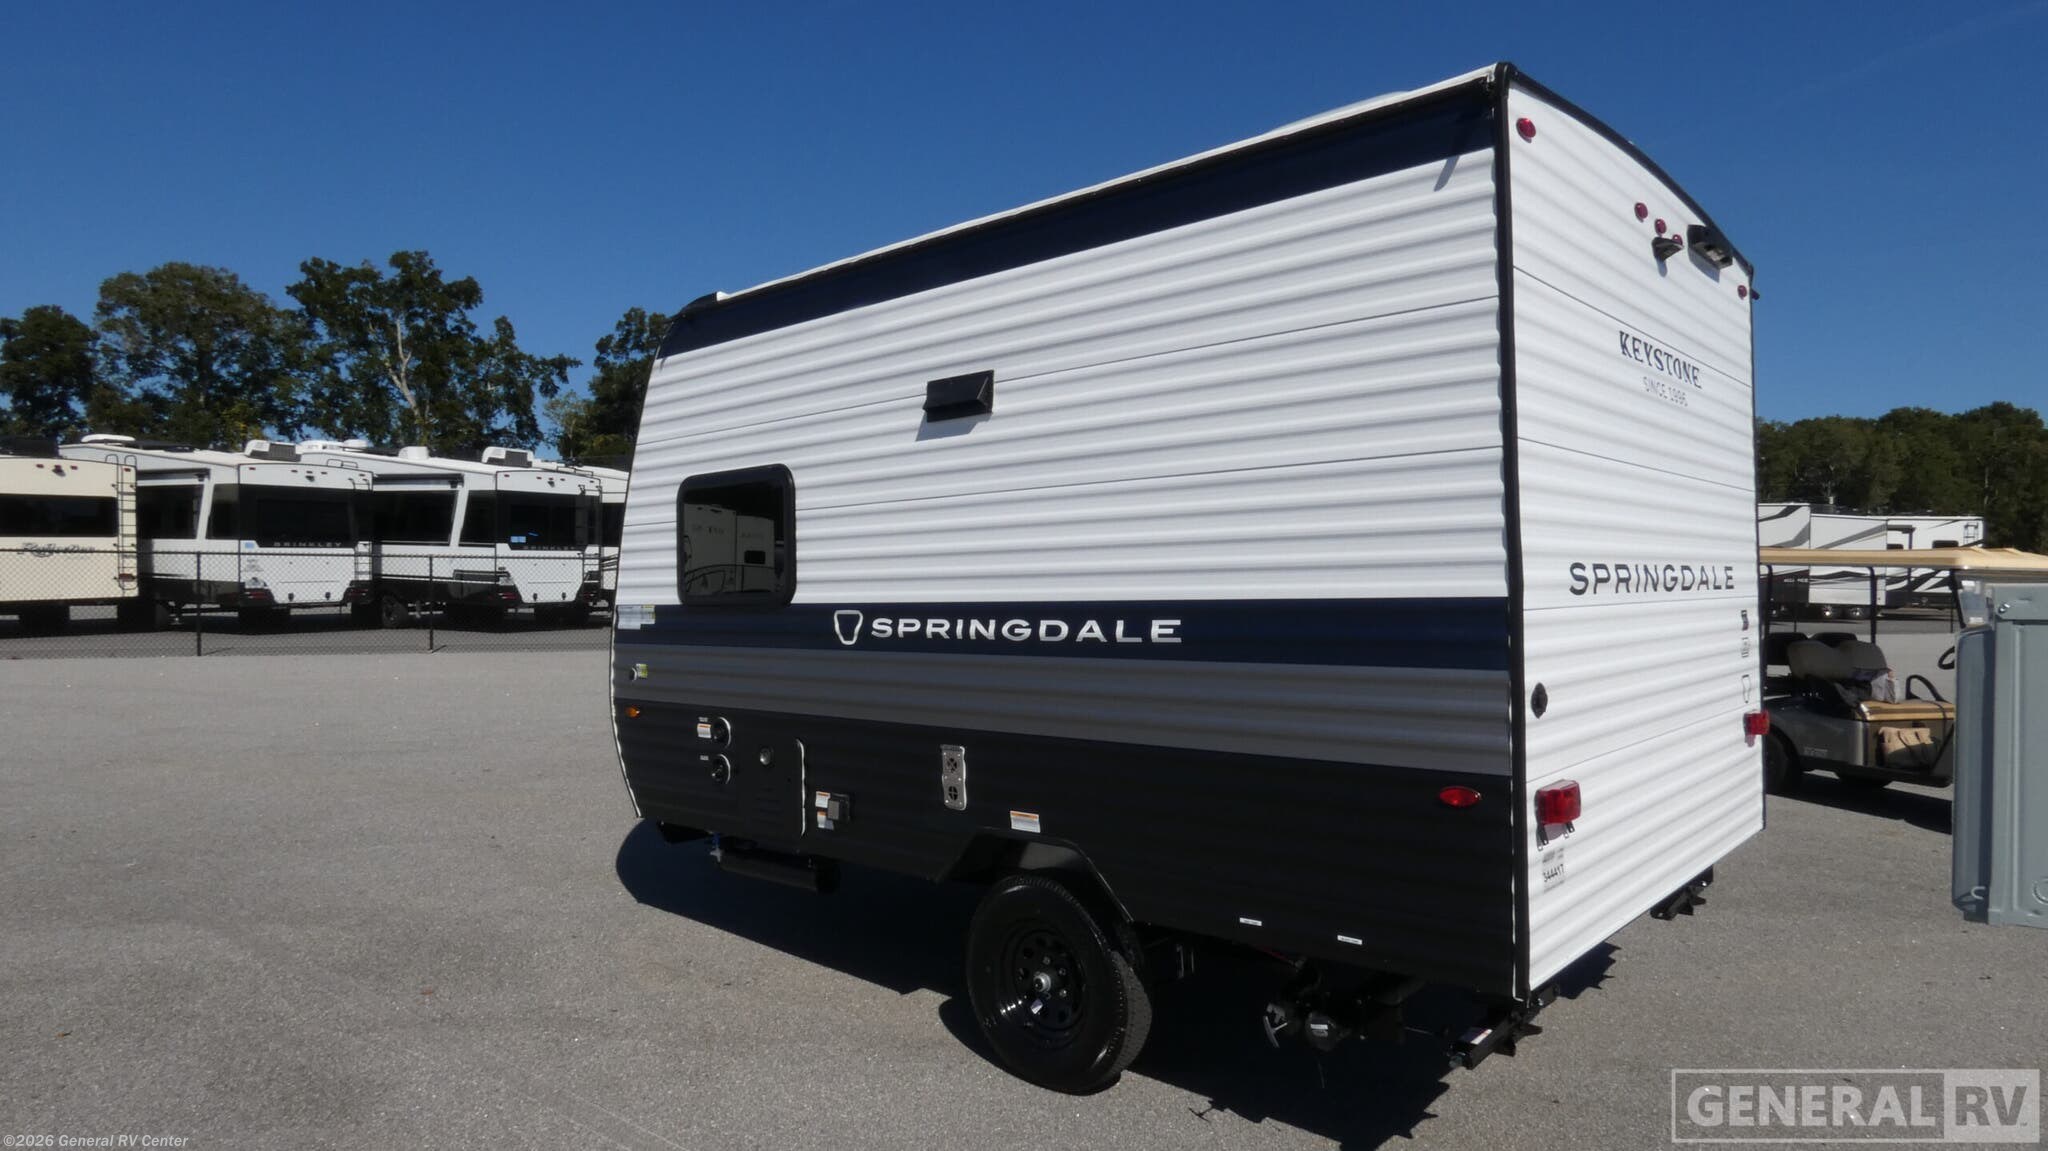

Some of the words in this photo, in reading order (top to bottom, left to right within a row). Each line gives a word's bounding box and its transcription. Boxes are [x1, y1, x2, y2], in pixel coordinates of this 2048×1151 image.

[1619, 329, 1703, 390] KEYSTONE
[1642, 376, 1668, 400] SINCE
[1569, 562, 1735, 596] SPRINGDALE
[871, 617, 1183, 643] SPRINGDALE
